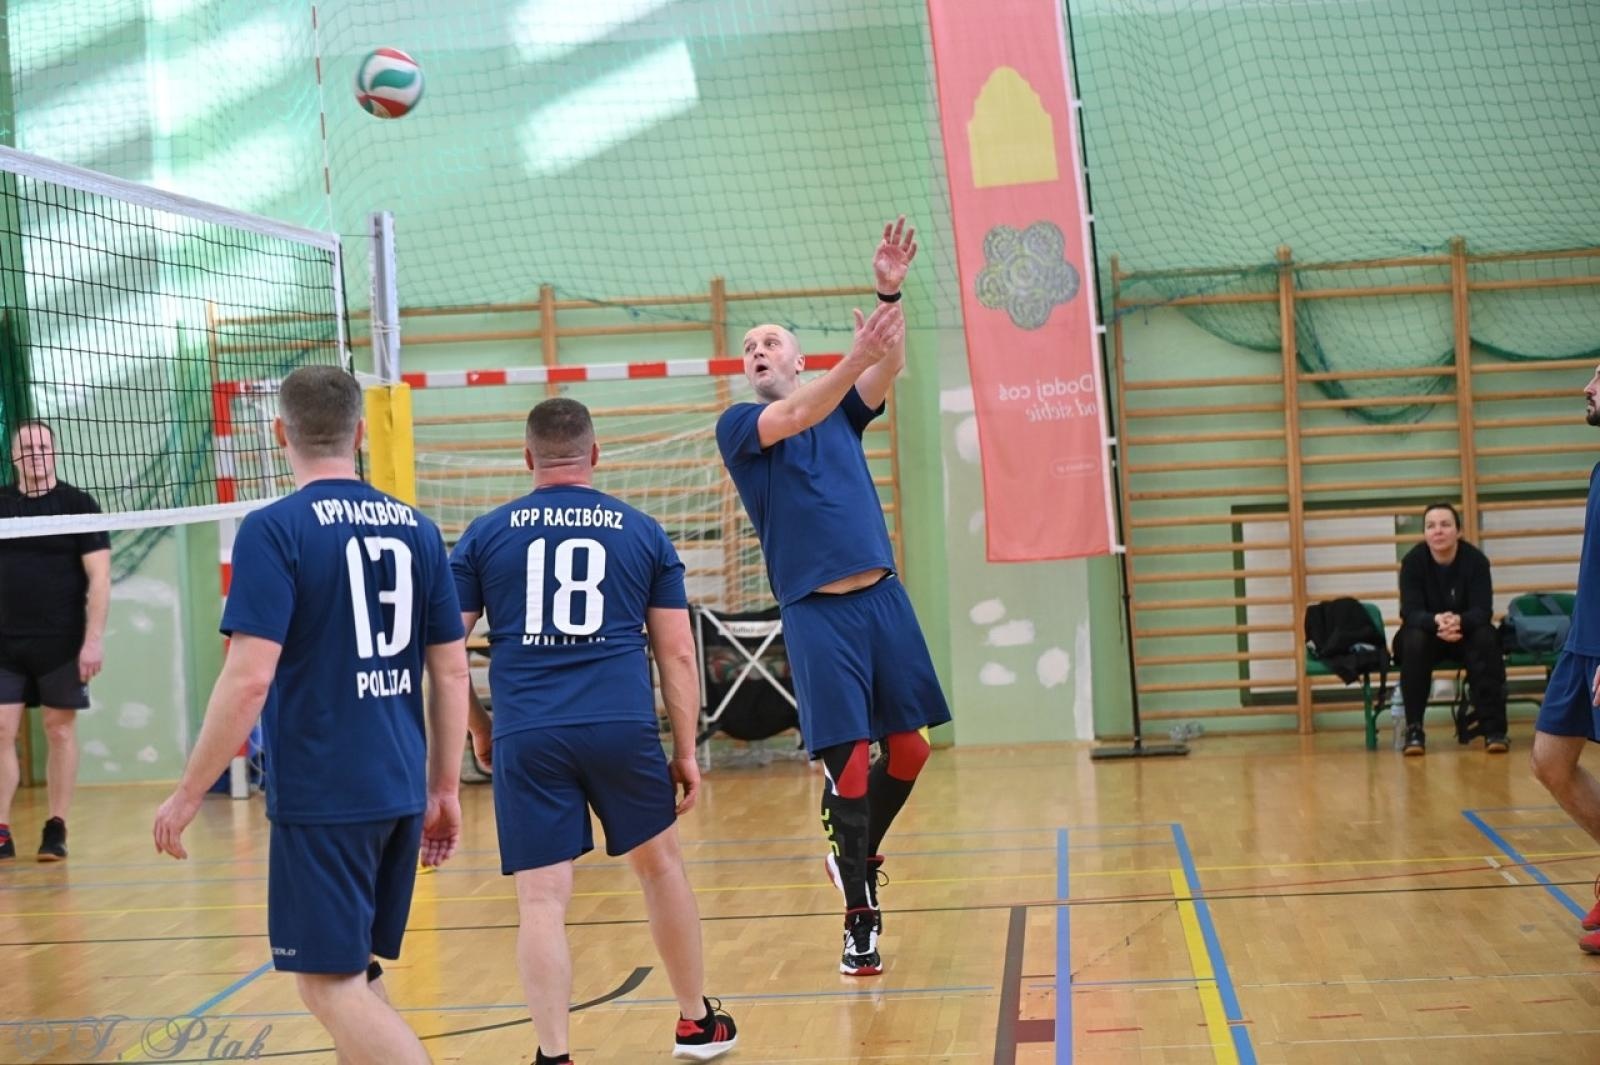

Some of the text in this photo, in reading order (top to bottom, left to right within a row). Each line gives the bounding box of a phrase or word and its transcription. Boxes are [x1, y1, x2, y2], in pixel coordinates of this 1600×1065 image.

[311, 498, 343, 526] KPP
[510, 504, 624, 530] KPP RACIBÓRZ
[345, 536, 413, 659] 13
[525, 537, 606, 636] 18
